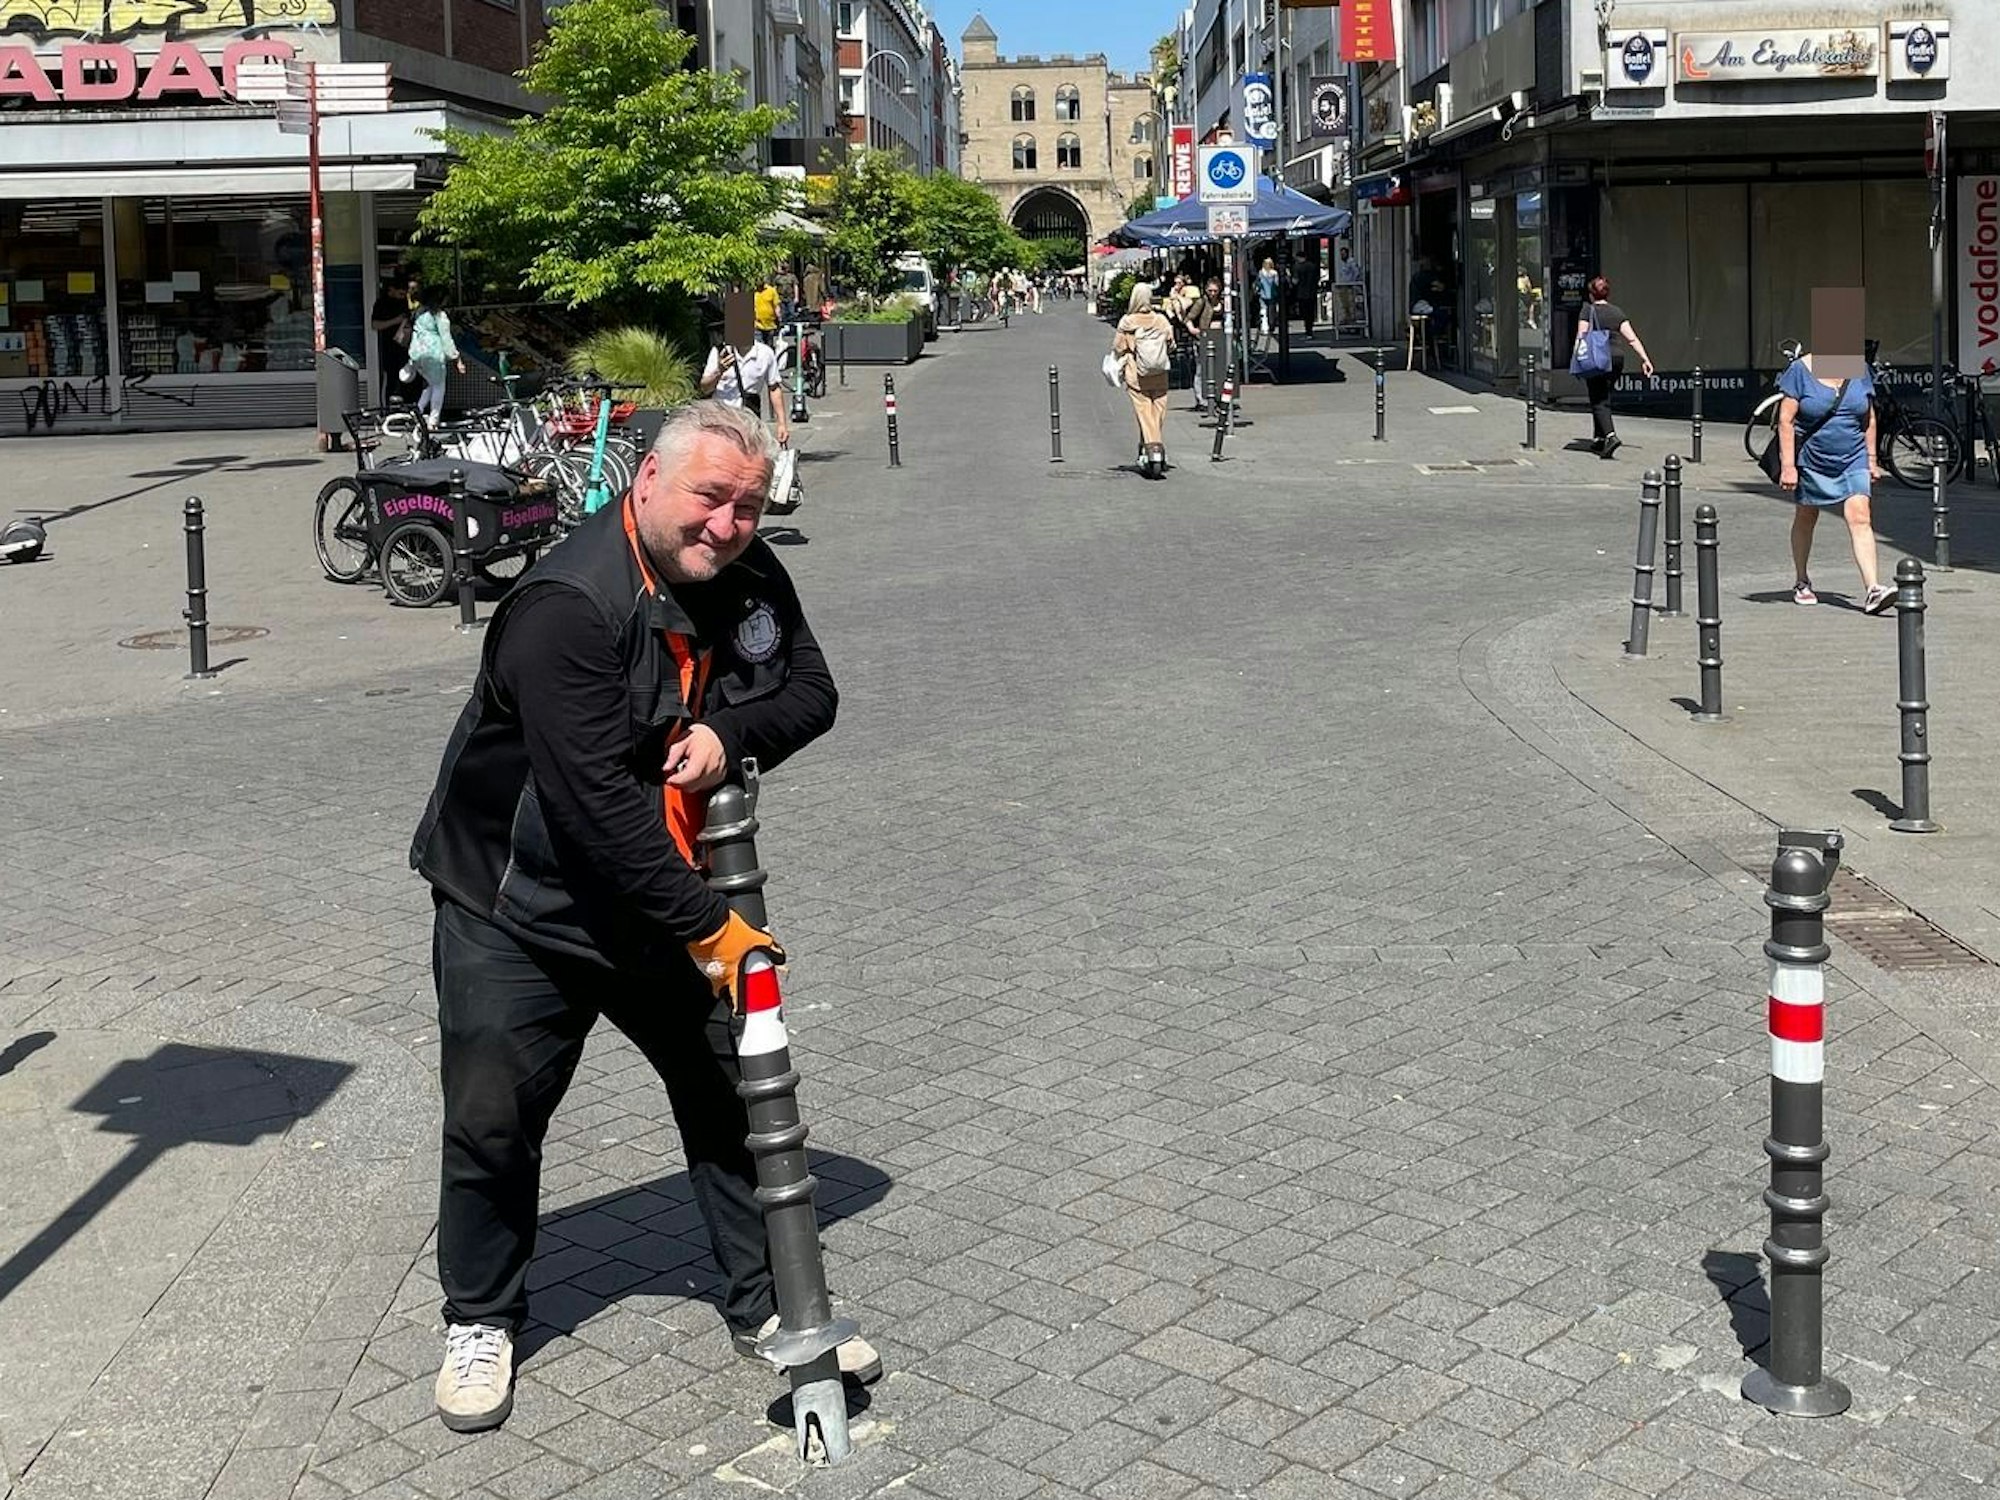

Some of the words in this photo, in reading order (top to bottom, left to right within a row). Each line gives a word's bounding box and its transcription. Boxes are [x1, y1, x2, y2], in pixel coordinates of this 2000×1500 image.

[1624, 52, 1651, 64] Gaffel
[1700, 40, 1745, 67] Am
[1175, 143, 1191, 193] REWE
[1969, 180, 1999, 348] vodafone
[1650, 374, 1745, 394] REPARTUREN
[383, 494, 455, 521] EigelBike
[502, 502, 556, 529] EigelBike
